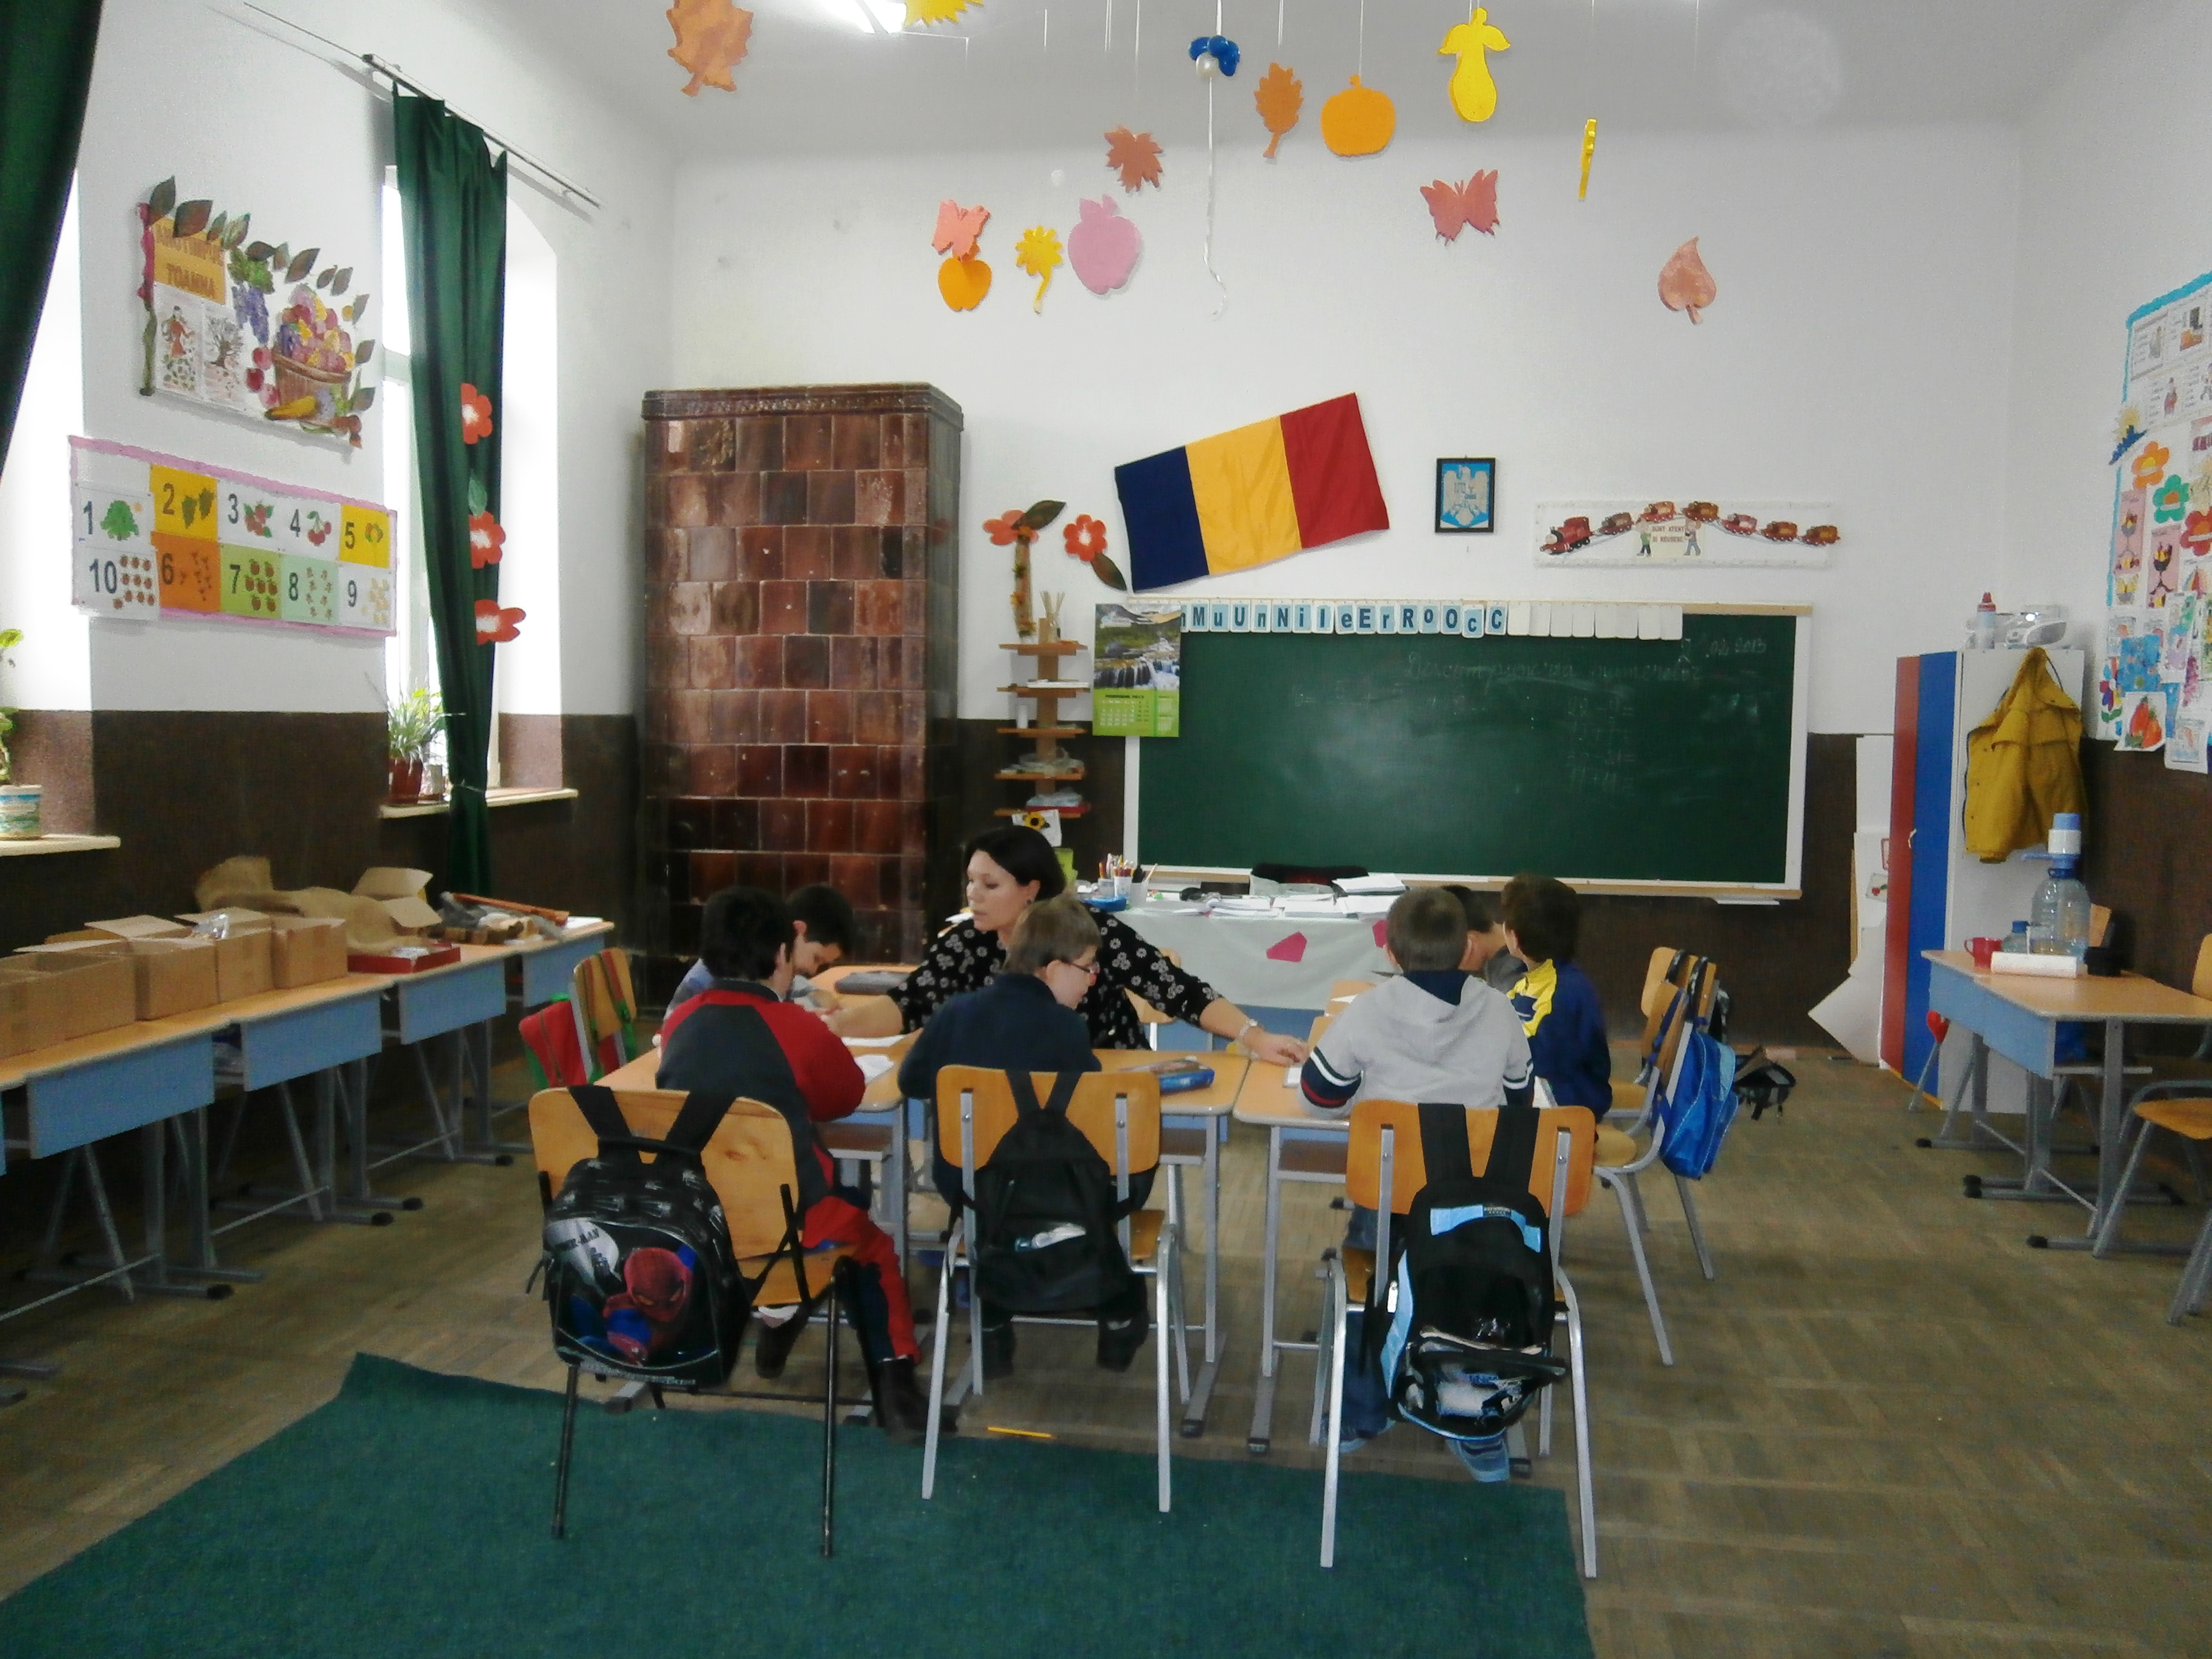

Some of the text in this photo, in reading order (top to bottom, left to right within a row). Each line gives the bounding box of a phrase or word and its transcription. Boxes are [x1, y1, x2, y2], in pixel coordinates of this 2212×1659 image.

[83, 483, 355, 549] 1 2 3 4 5
[89, 552, 357, 607] 10 6 7 8 9
